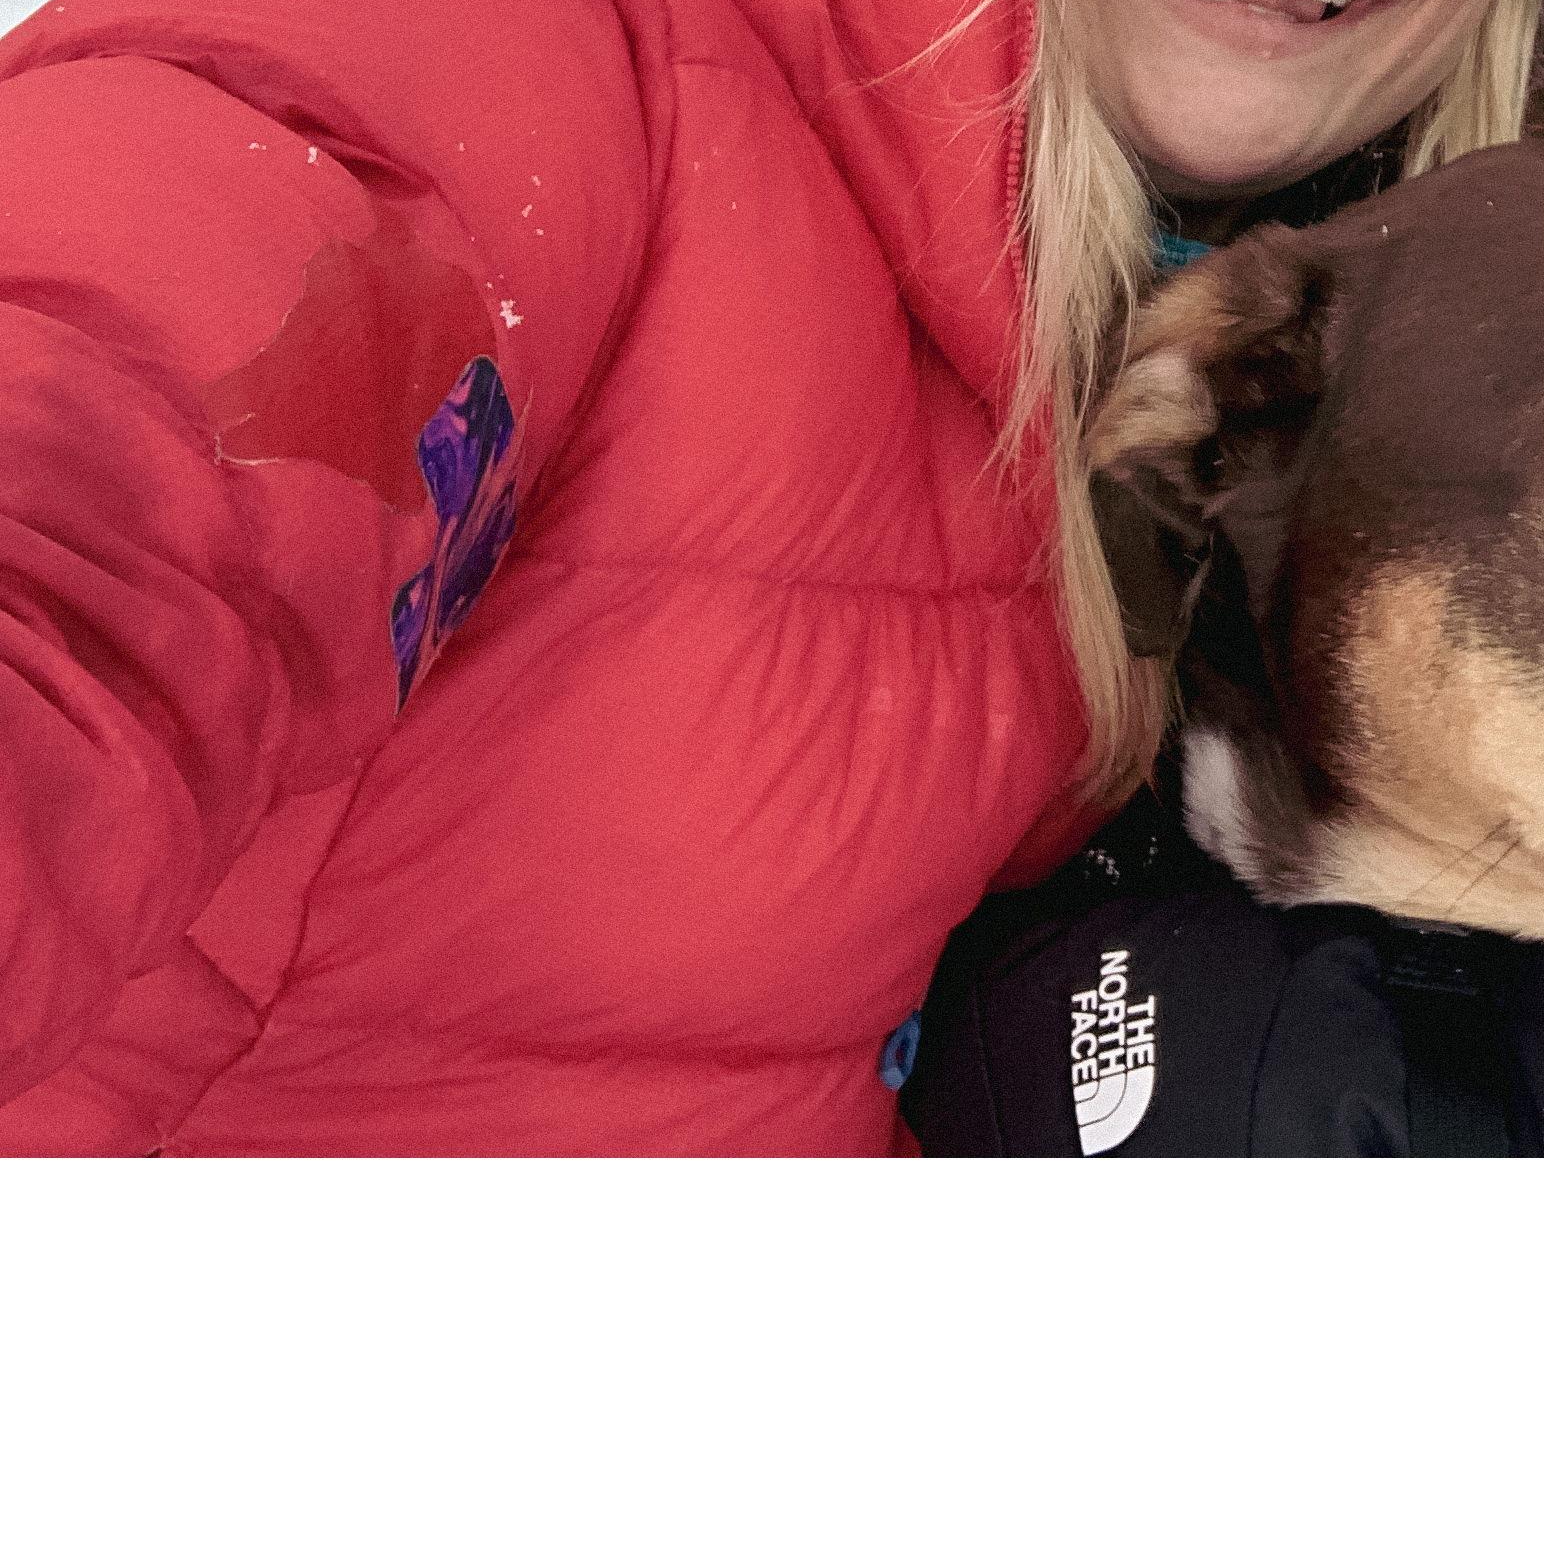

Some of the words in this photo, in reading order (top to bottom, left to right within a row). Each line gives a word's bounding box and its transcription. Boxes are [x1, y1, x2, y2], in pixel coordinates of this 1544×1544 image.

[1070, 989, 1099, 1085] FACE
[1098, 950, 1130, 1076] NORTH
[1126, 994, 1155, 1070] THE
